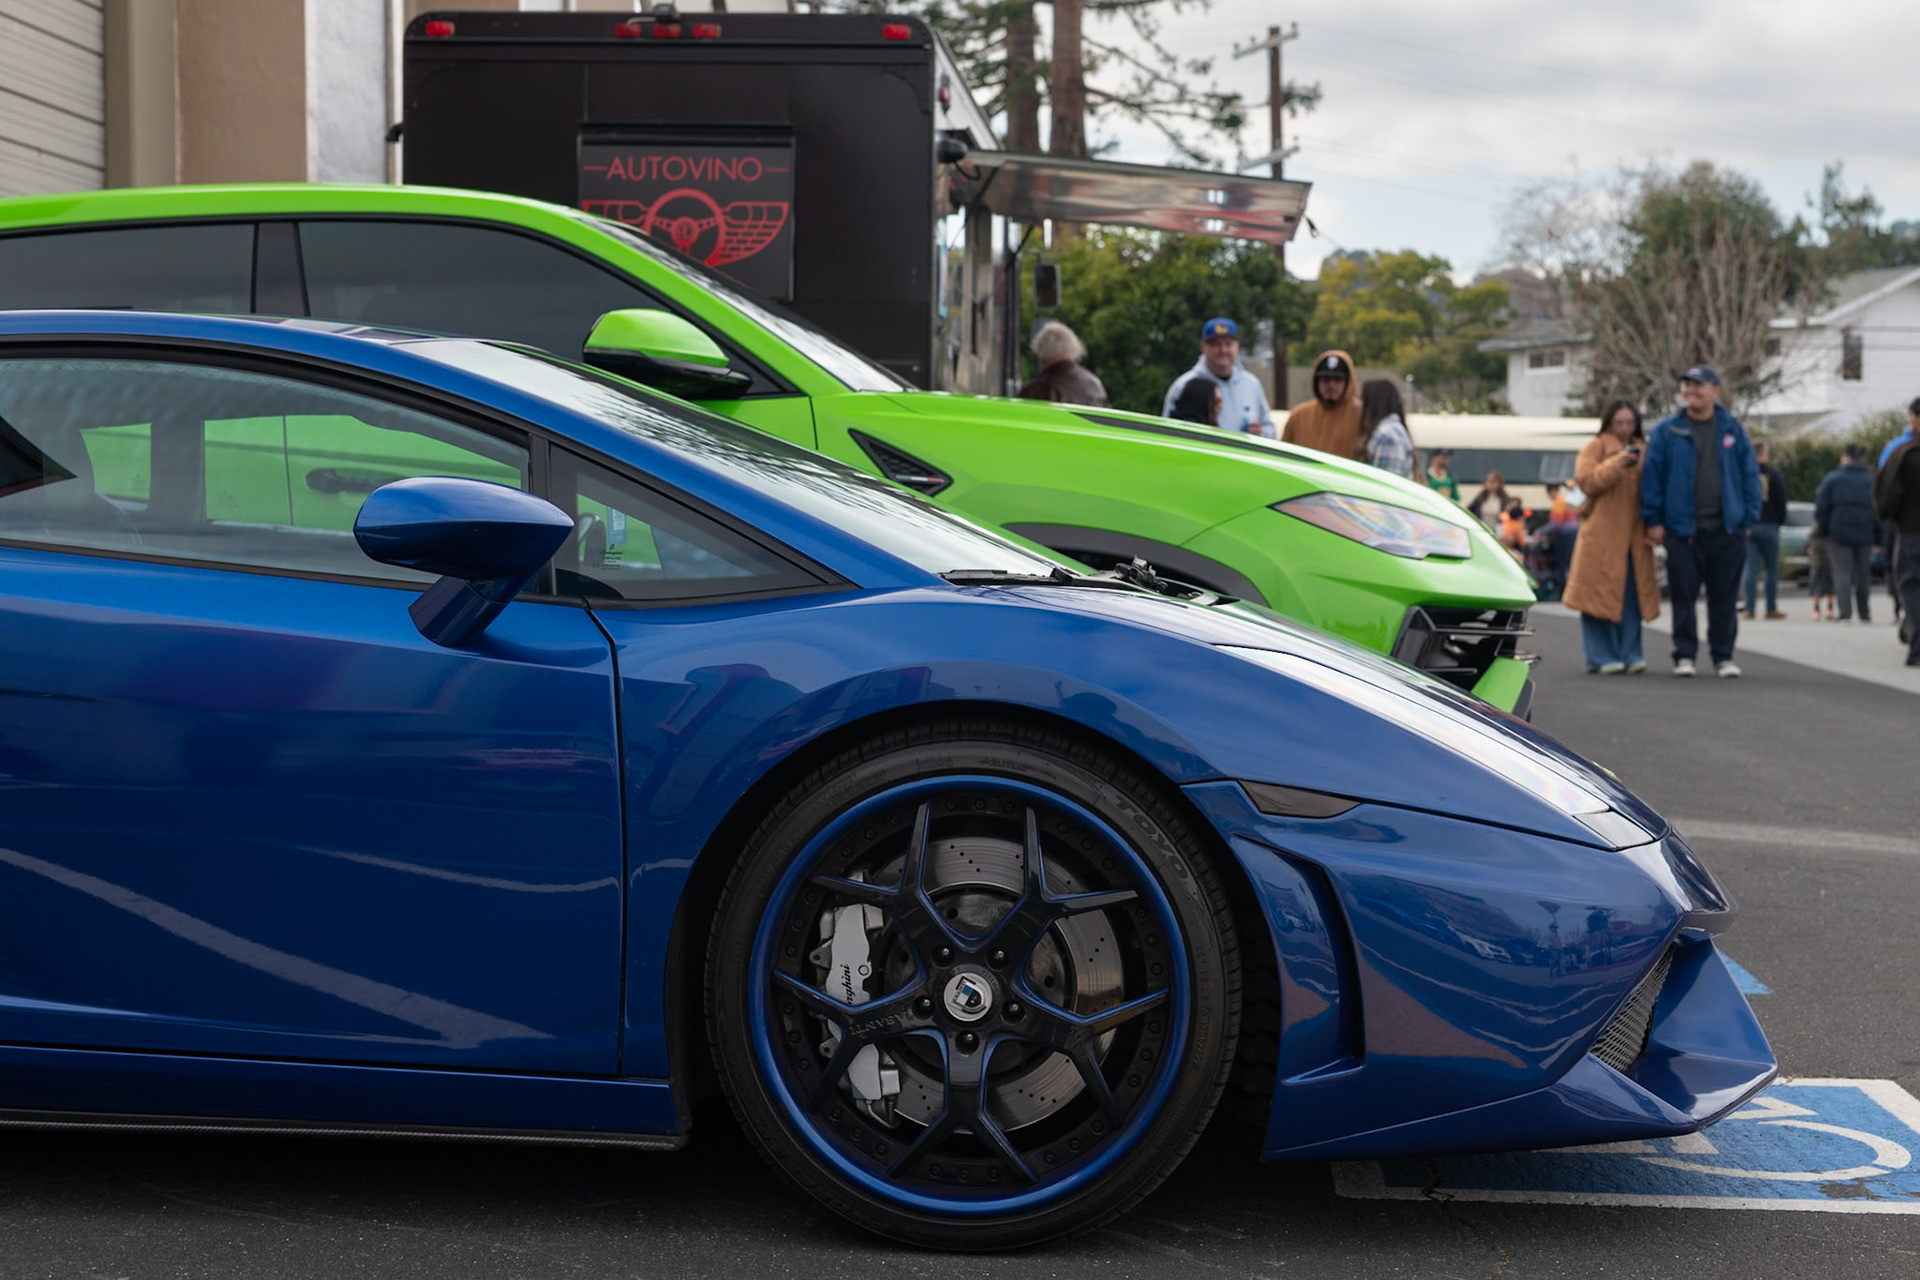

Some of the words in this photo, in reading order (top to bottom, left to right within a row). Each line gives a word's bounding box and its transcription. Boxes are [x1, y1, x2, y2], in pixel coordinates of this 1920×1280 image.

[606, 155, 763, 182] AUTOVINO
[1114, 793, 1189, 880] TOYO
[840, 964, 856, 1005] rghini
